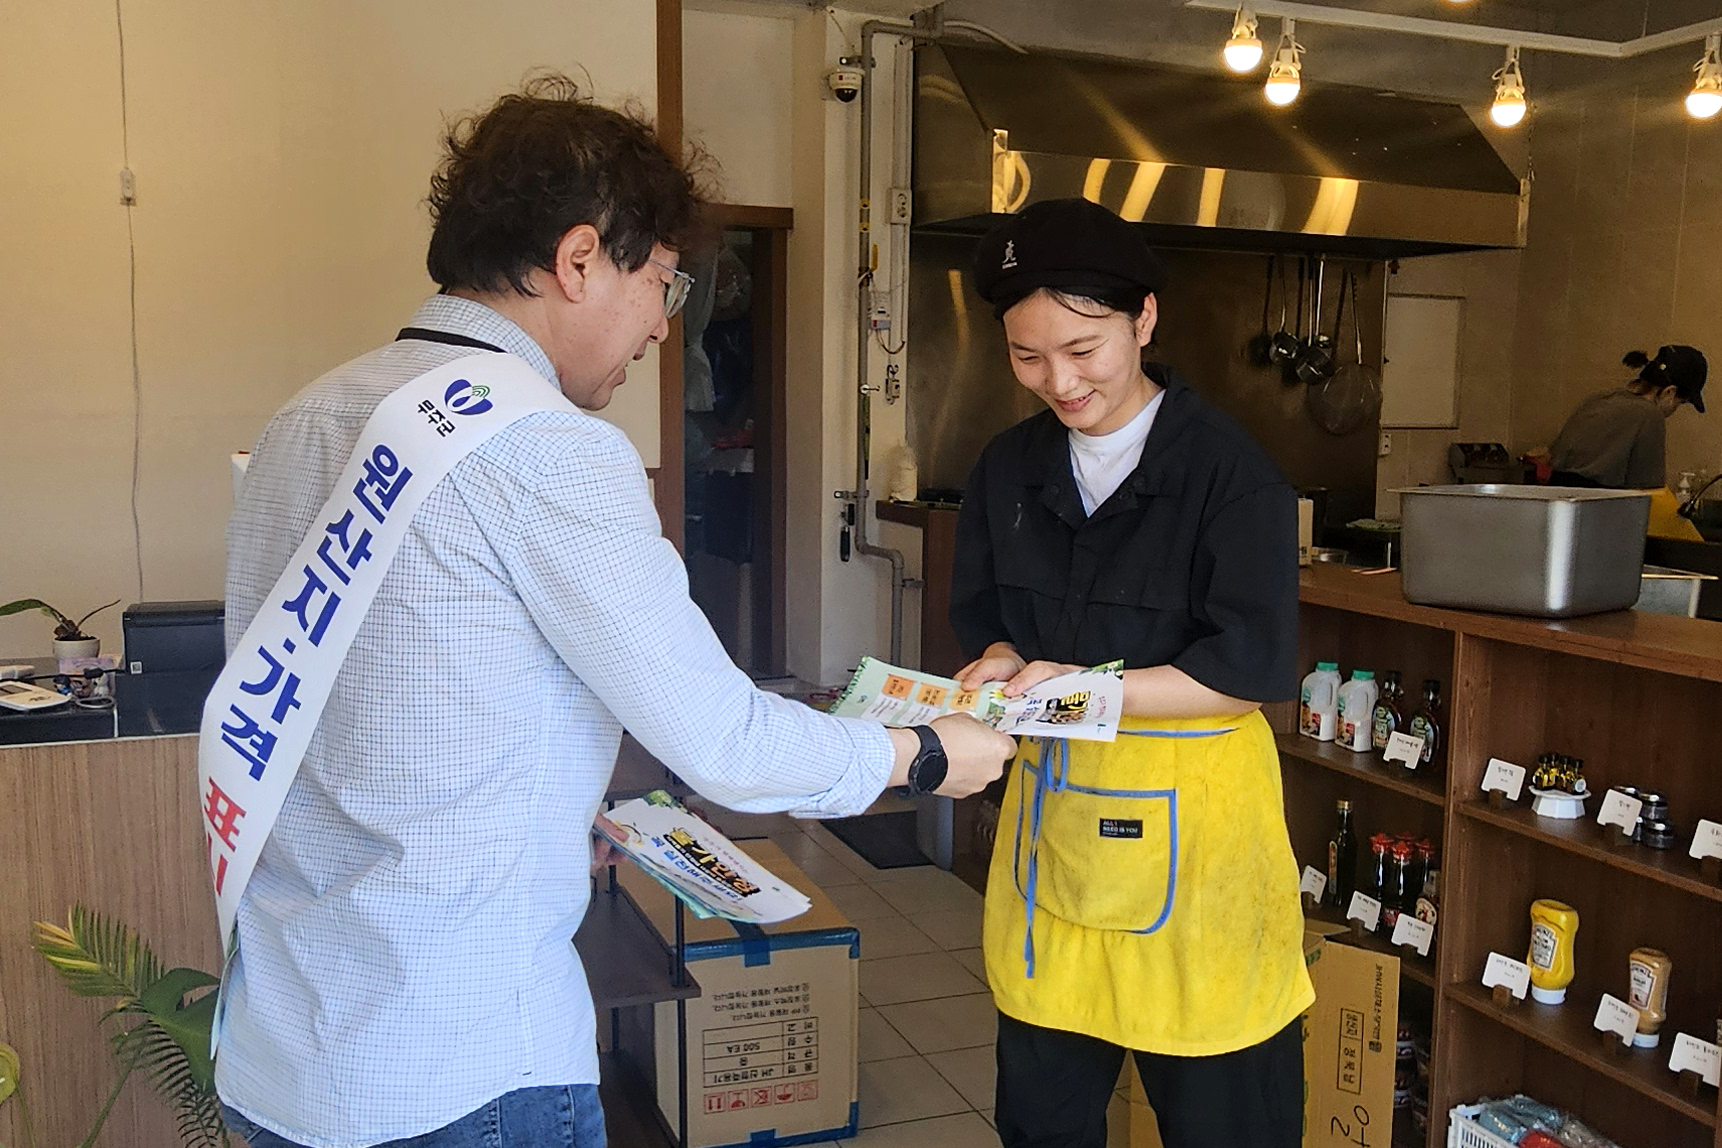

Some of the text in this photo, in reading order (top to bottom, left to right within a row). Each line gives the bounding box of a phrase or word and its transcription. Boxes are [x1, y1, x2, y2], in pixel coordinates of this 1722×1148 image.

[417, 399, 456, 437] 무주군
[670, 829, 759, 895] 물가안정
[727, 1044, 740, 1053] EA
